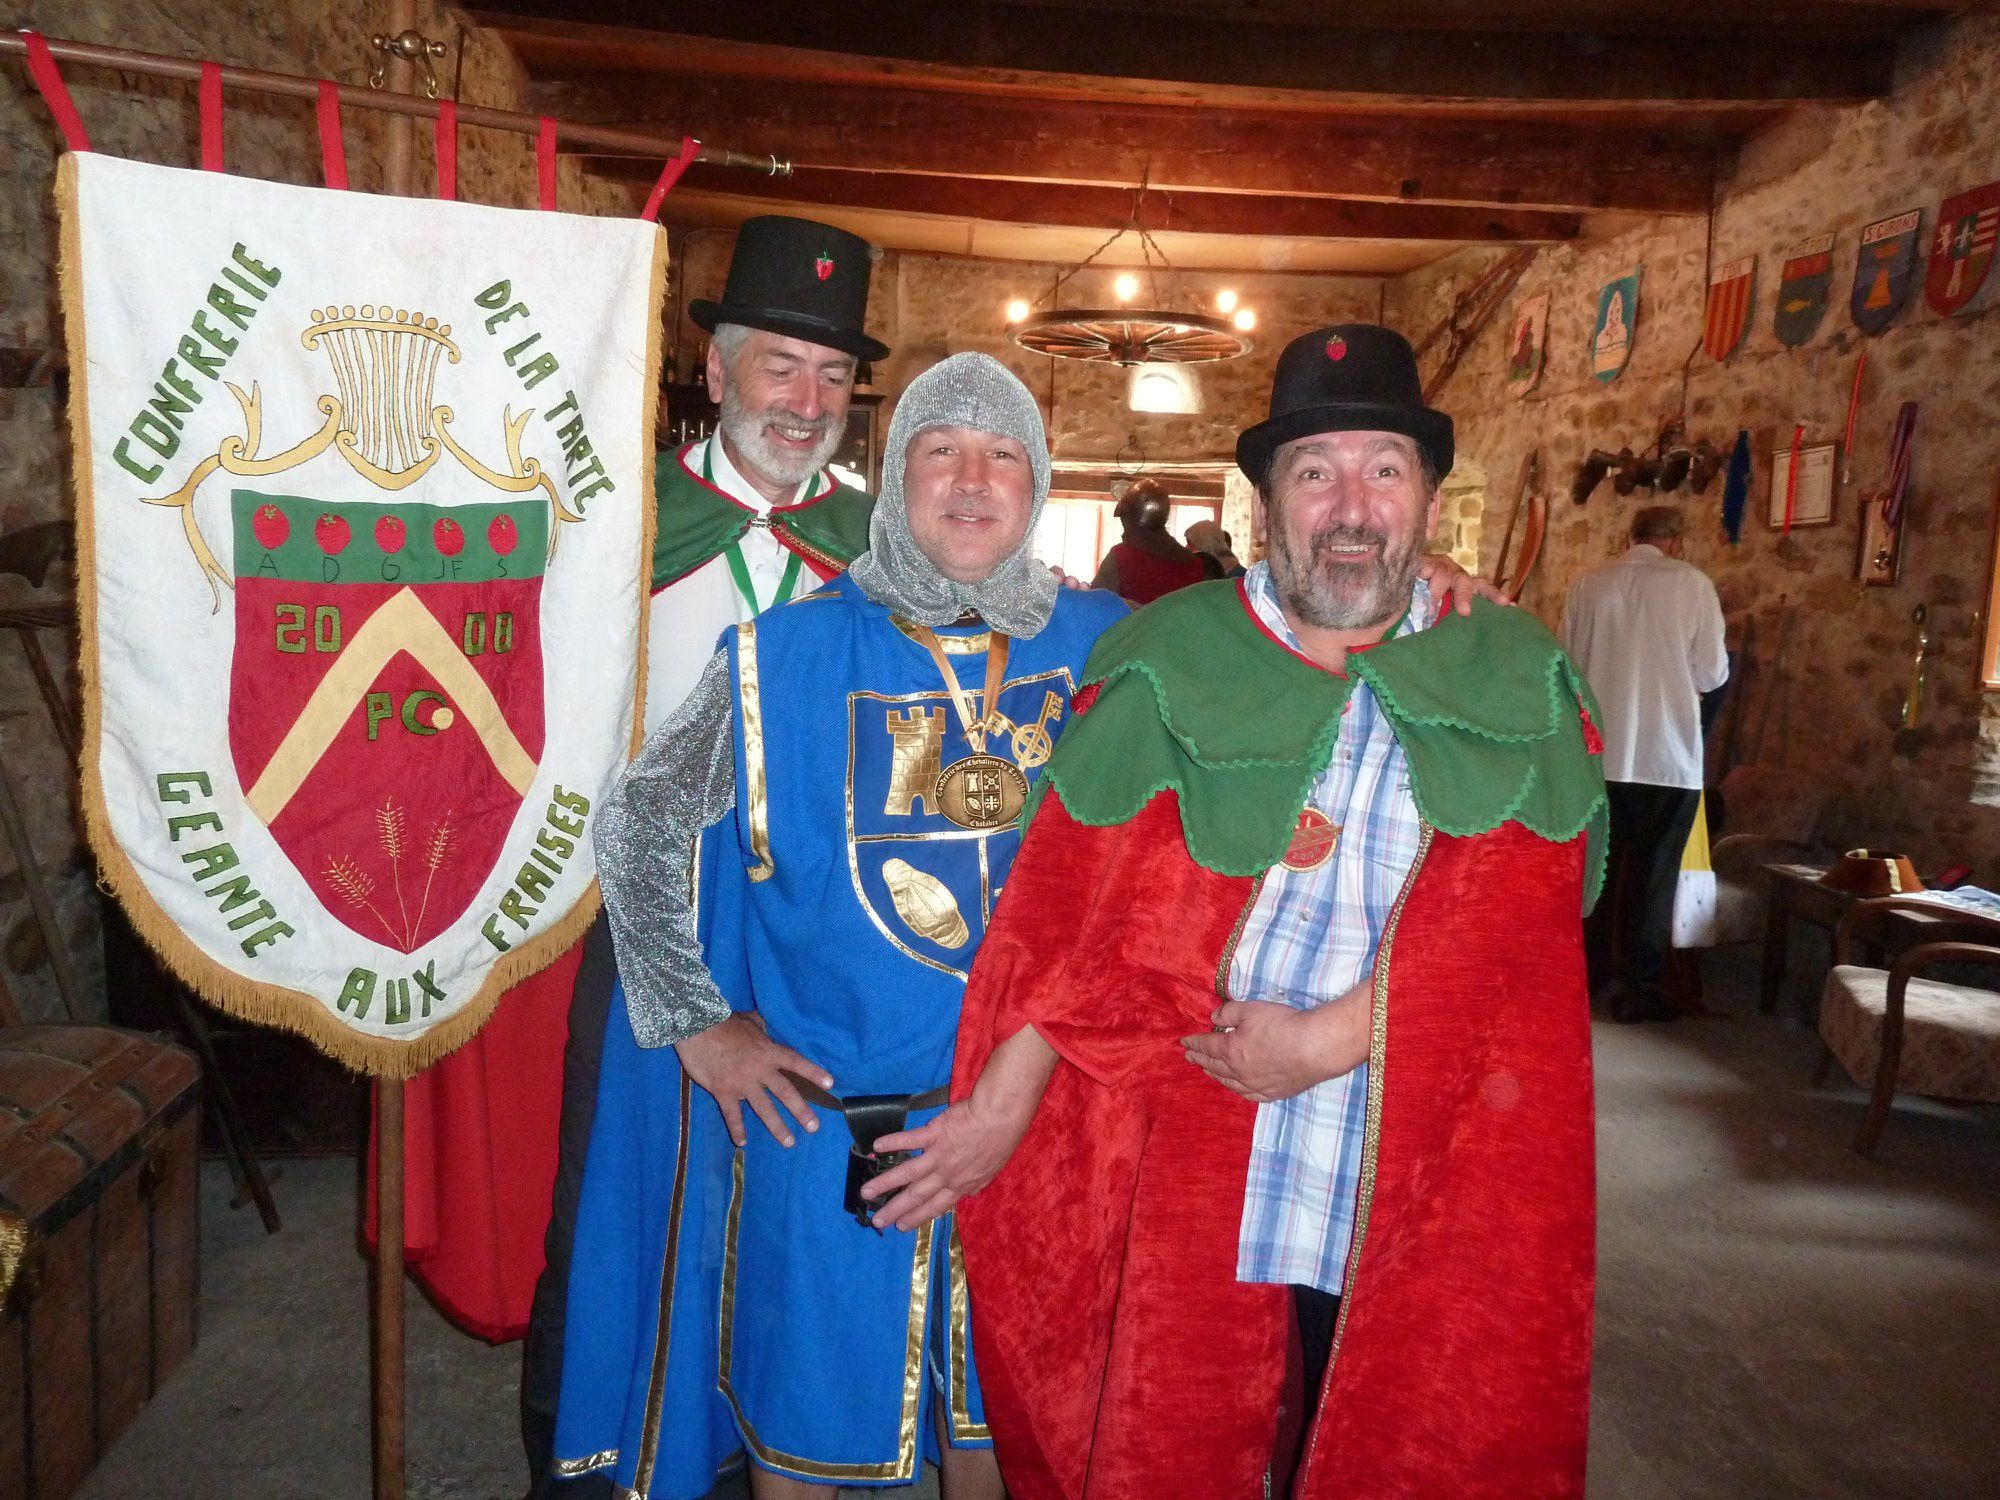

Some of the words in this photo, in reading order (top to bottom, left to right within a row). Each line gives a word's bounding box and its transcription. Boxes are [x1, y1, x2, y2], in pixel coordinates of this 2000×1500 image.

[112, 242, 282, 485] CONFRERIE
[474, 279, 530, 335] DE
[503, 332, 560, 391] LA
[544, 390, 616, 514] TARTE
[257, 552, 280, 578] A
[322, 556, 341, 584] D
[156, 770, 297, 958] GEANTE
[336, 959, 447, 1026] AUX
[480, 784, 592, 953] FRAISES
